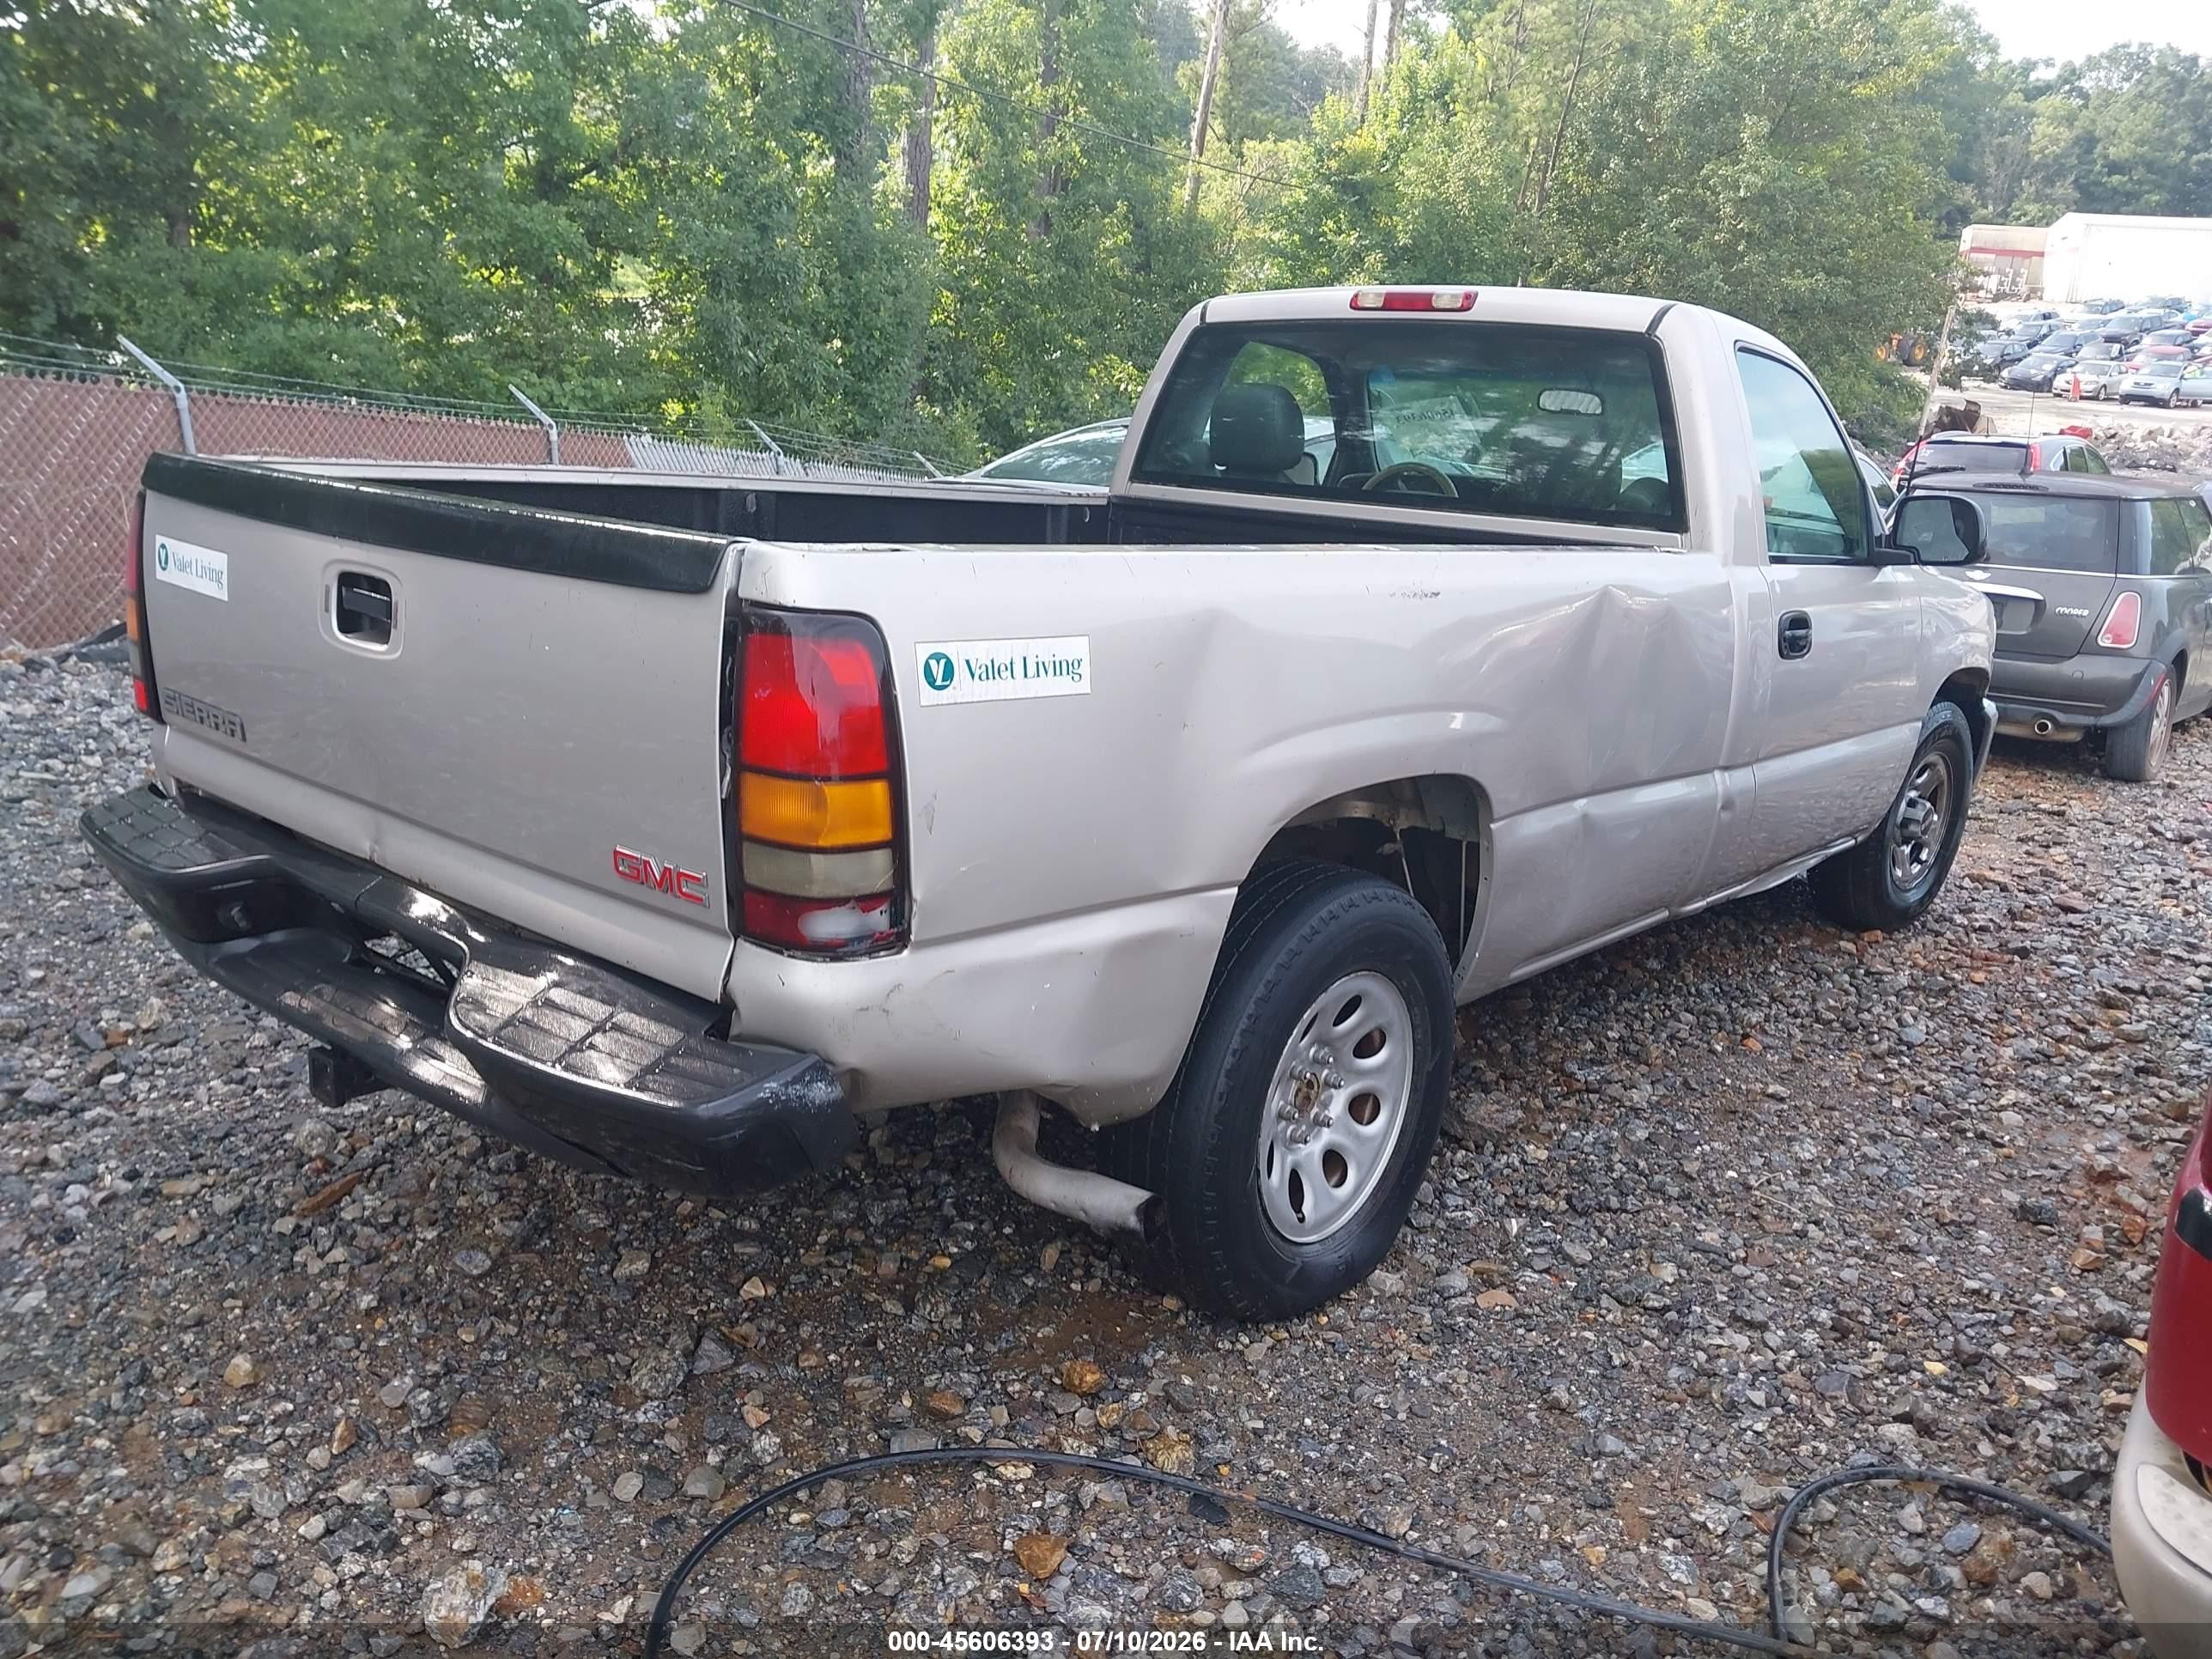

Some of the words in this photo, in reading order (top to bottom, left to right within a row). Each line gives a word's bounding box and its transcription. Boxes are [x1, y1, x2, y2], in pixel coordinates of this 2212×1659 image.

[172, 550, 193, 575] Valet
[195, 556, 224, 590] Living
[964, 655, 1017, 683] Valet
[1022, 653, 1083, 684] Living
[161, 686, 247, 743] SIERRA
[612, 843, 711, 908] GMC
